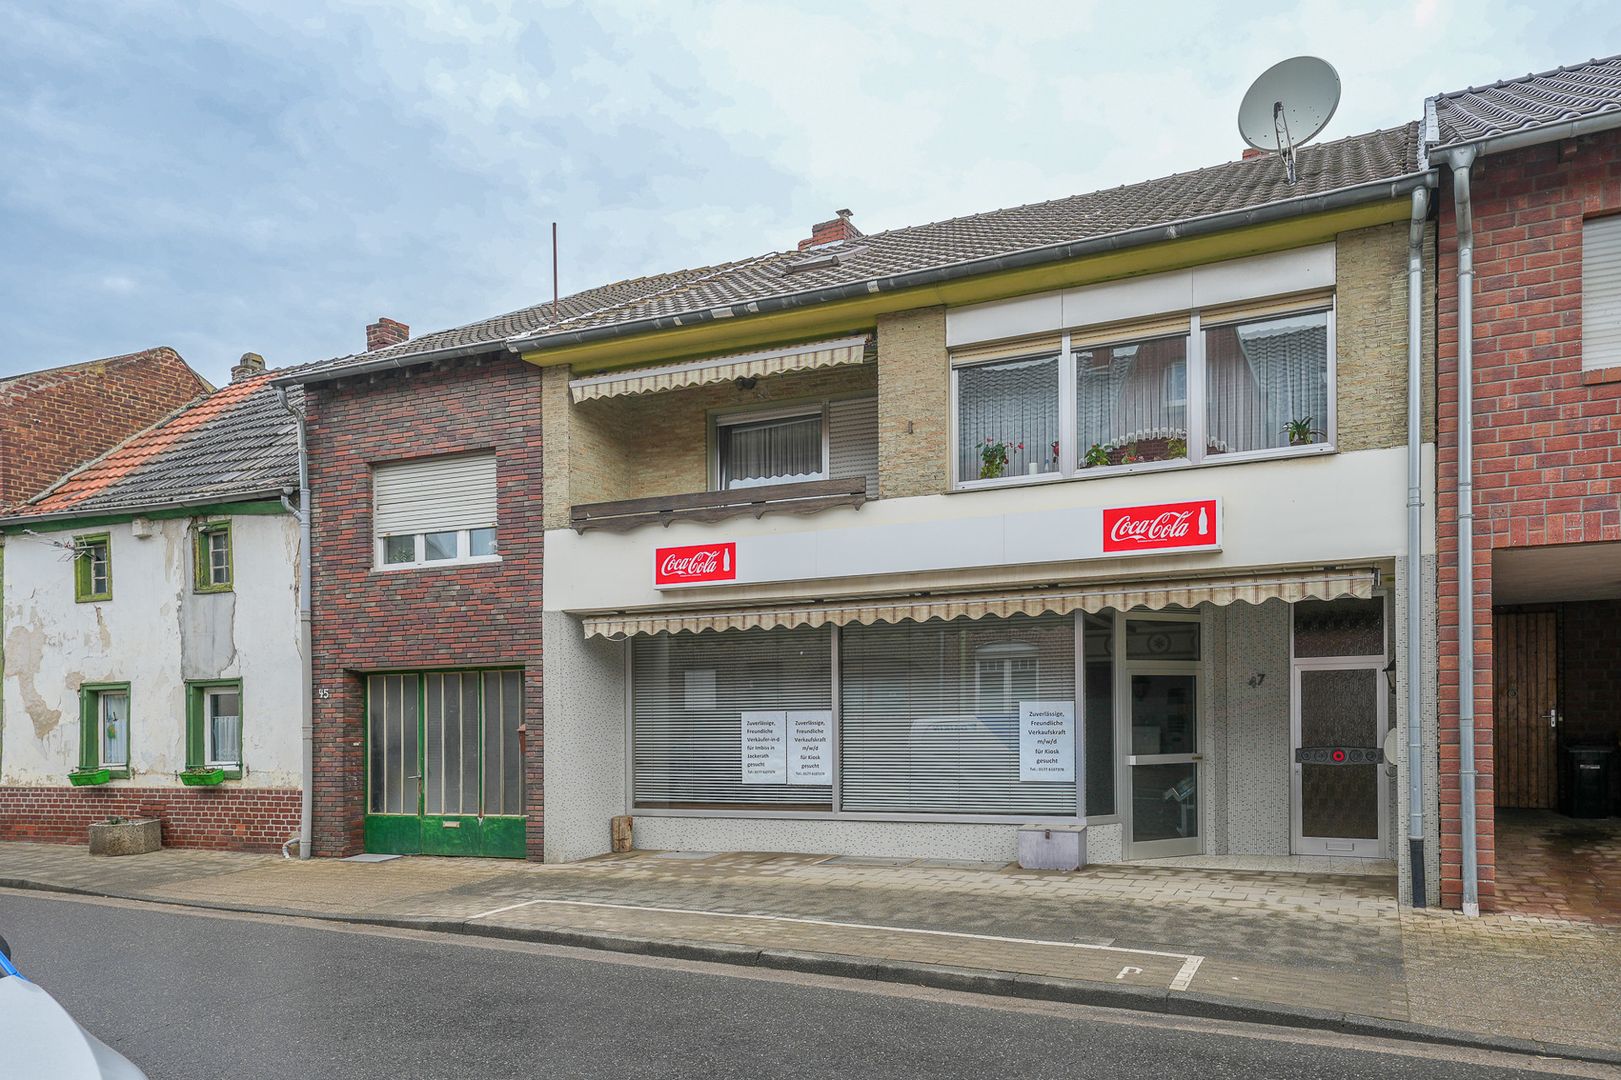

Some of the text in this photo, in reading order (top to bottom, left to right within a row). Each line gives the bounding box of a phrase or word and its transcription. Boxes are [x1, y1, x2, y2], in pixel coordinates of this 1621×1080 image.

[1110, 510, 1194, 542] Coca-Cola
[661, 550, 720, 576] Coca-Cola
[318, 688, 329, 699] 45
[1116, 966, 1143, 979] P
